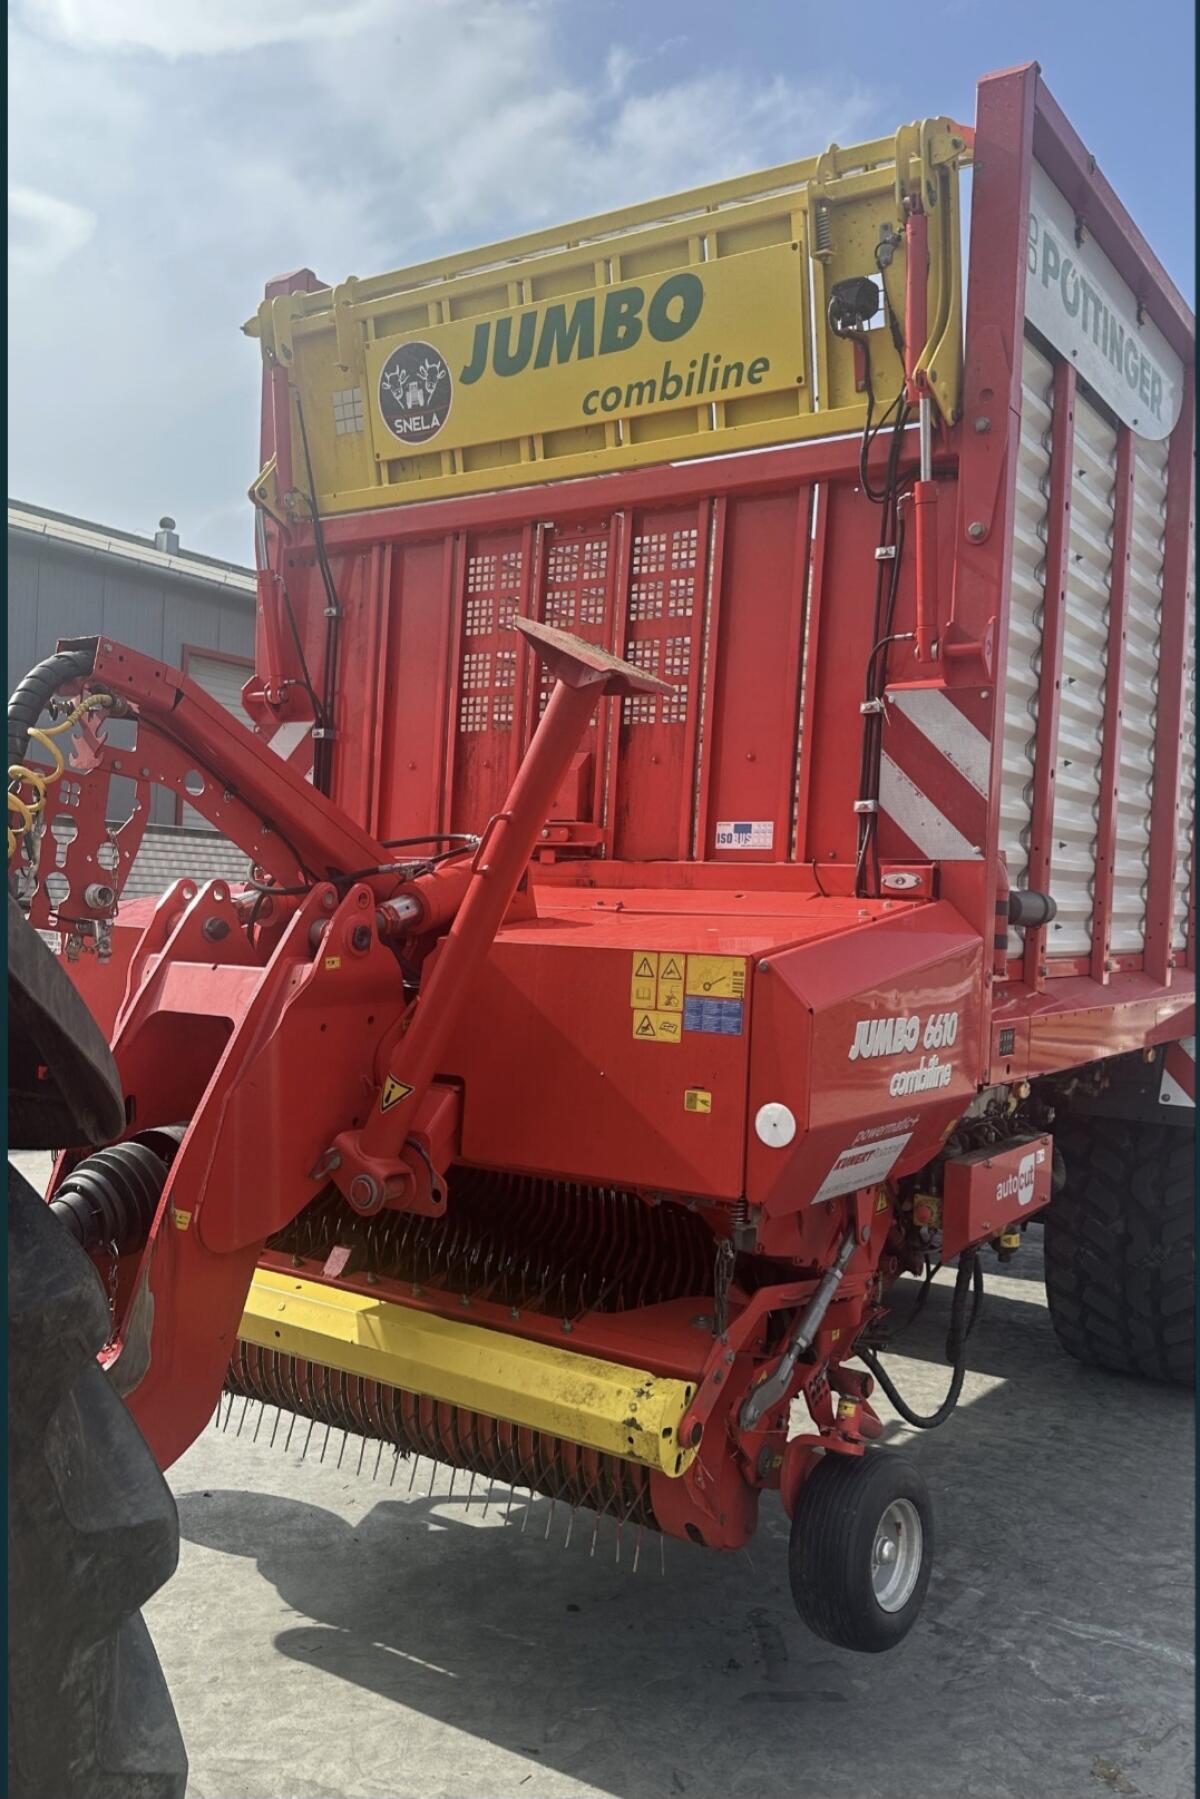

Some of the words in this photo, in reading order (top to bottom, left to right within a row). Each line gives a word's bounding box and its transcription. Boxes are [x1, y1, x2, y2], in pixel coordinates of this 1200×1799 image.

[459, 272, 704, 386] JUMBO
[582, 352, 770, 417] combiline
[394, 413, 440, 434] SNELA
[848, 1016, 920, 1061] JUMBO
[923, 1011, 958, 1050] 6610
[889, 1054, 952, 1097] combiline
[996, 1165, 1034, 1201] autocut
